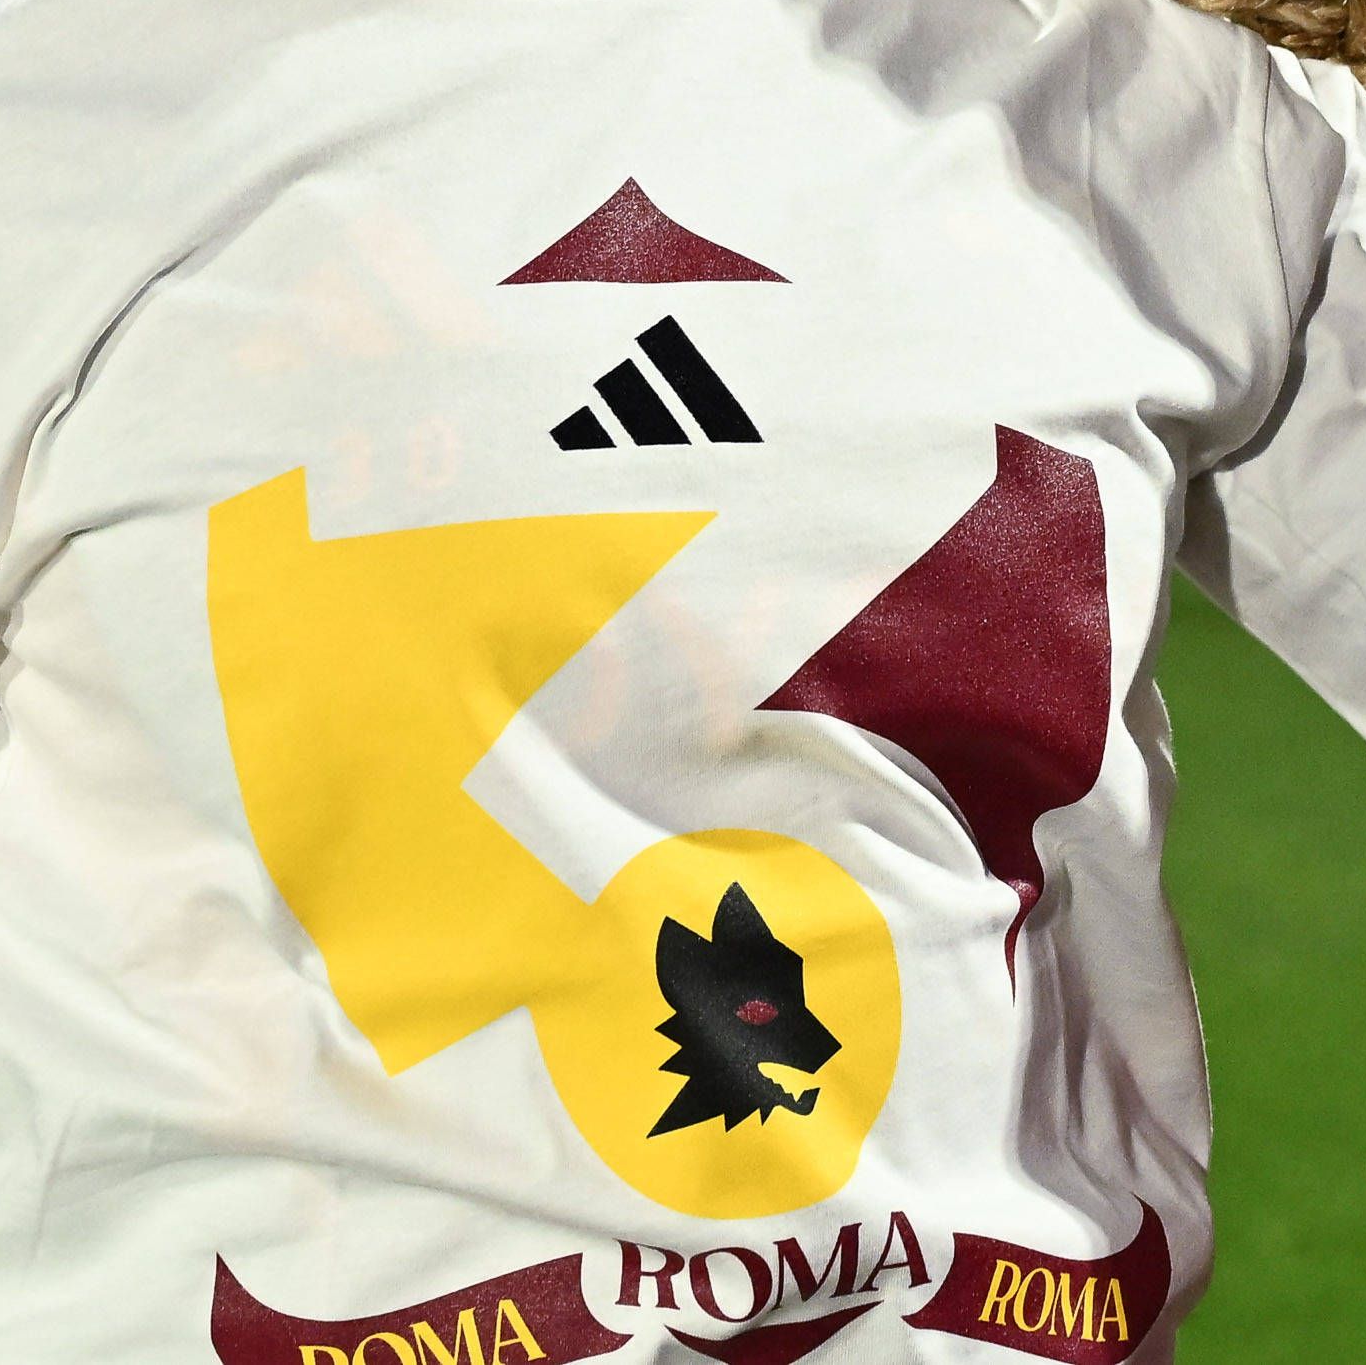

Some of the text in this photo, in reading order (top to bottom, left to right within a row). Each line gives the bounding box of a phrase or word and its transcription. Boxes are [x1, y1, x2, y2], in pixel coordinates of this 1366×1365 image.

[612, 1211, 933, 1323] ROMA
[977, 1259, 1130, 1343] ROMA
[299, 1298, 547, 1365] OMA
